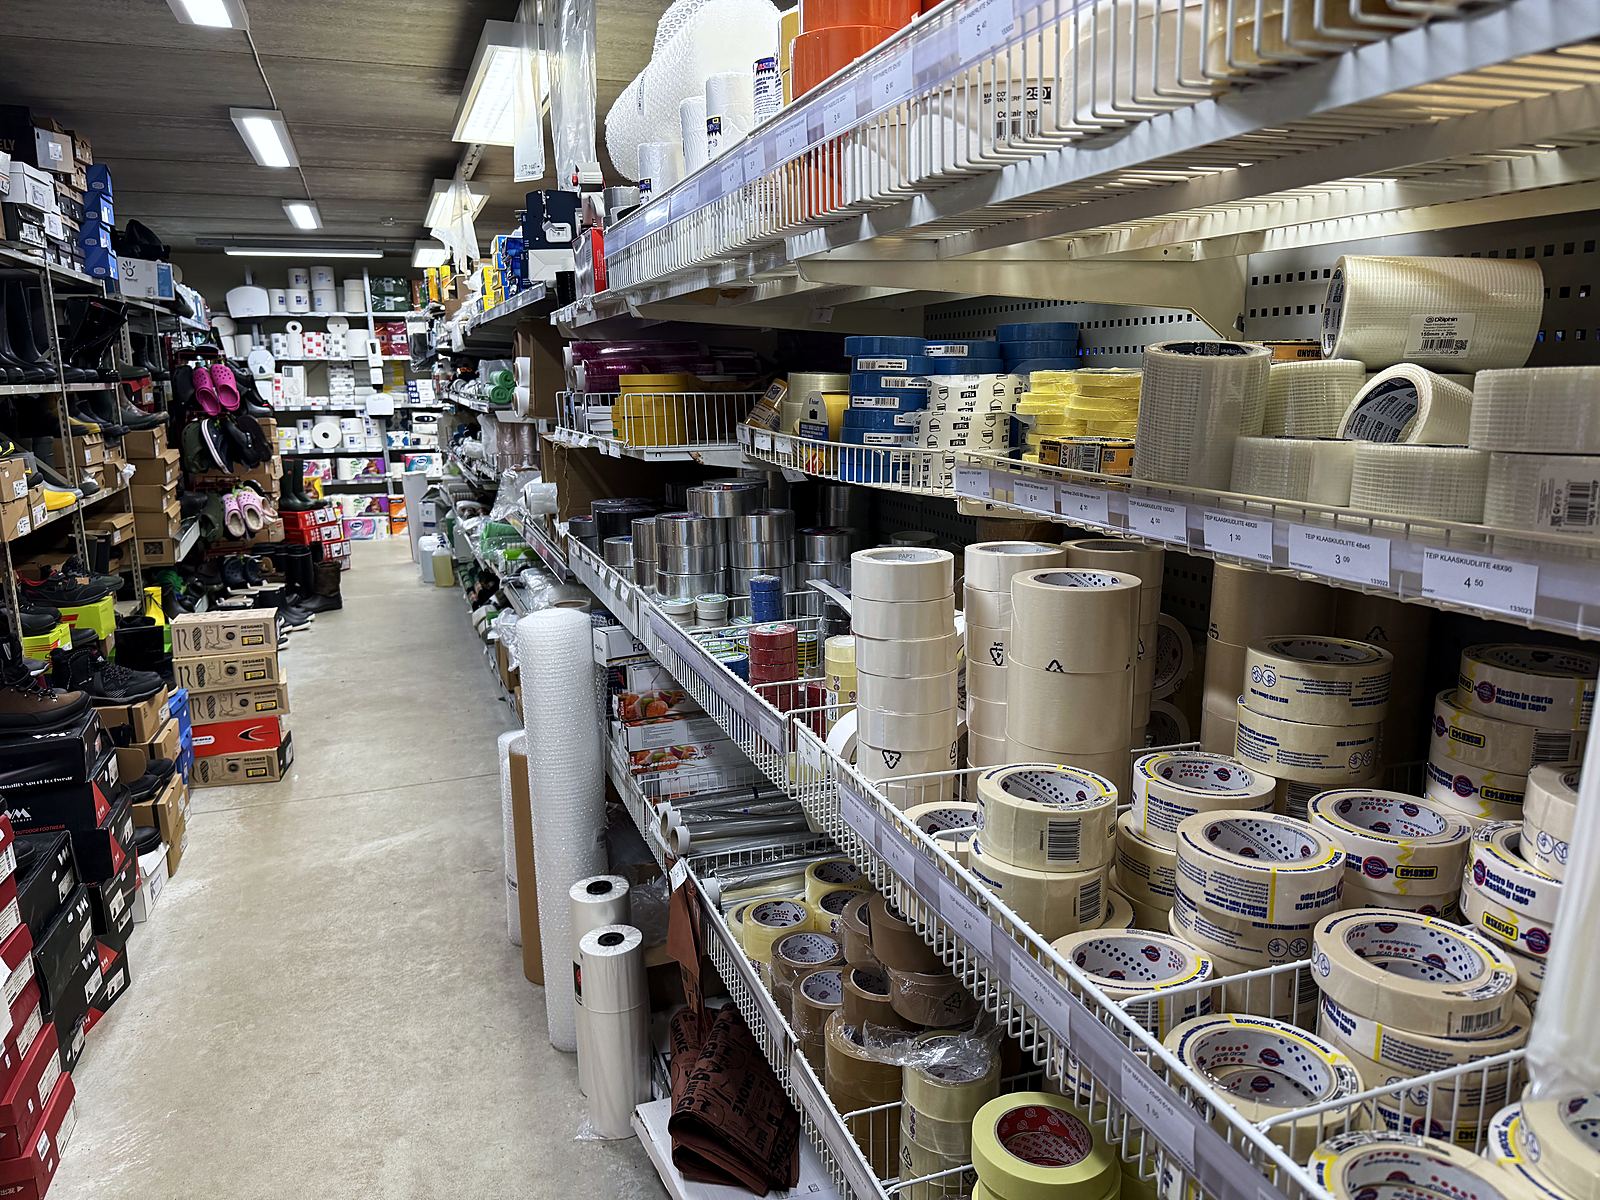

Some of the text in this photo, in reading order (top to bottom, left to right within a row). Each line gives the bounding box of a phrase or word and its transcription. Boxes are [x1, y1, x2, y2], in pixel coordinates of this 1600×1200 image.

[1150, 517, 1155, 525] 4
[1213, 516, 1245, 528] KLAASKIUDLIITE
[1316, 536, 1355, 548] KLAASKIUDLIITE
[1335, 554, 1341, 564] 3
[1425, 552, 1513, 573] TEIP KLAASKIUDLIITE 48X90
[1370, 578, 1388, 587] 133022
[1464, 577, 1483, 588] 4 50
[1509, 605, 1532, 614] 133023
[1496, 688, 1554, 704] Nastro in carta
[1495, 696, 1547, 712] Masking tape
[39, 824, 66, 832] FOOTWEAR
[1515, 882, 1536, 898] carta
[1512, 893, 1529, 906] tape
[1236, 1018, 1275, 1029] EUROCEL
[671, 1018, 689, 1054] SMOKE
